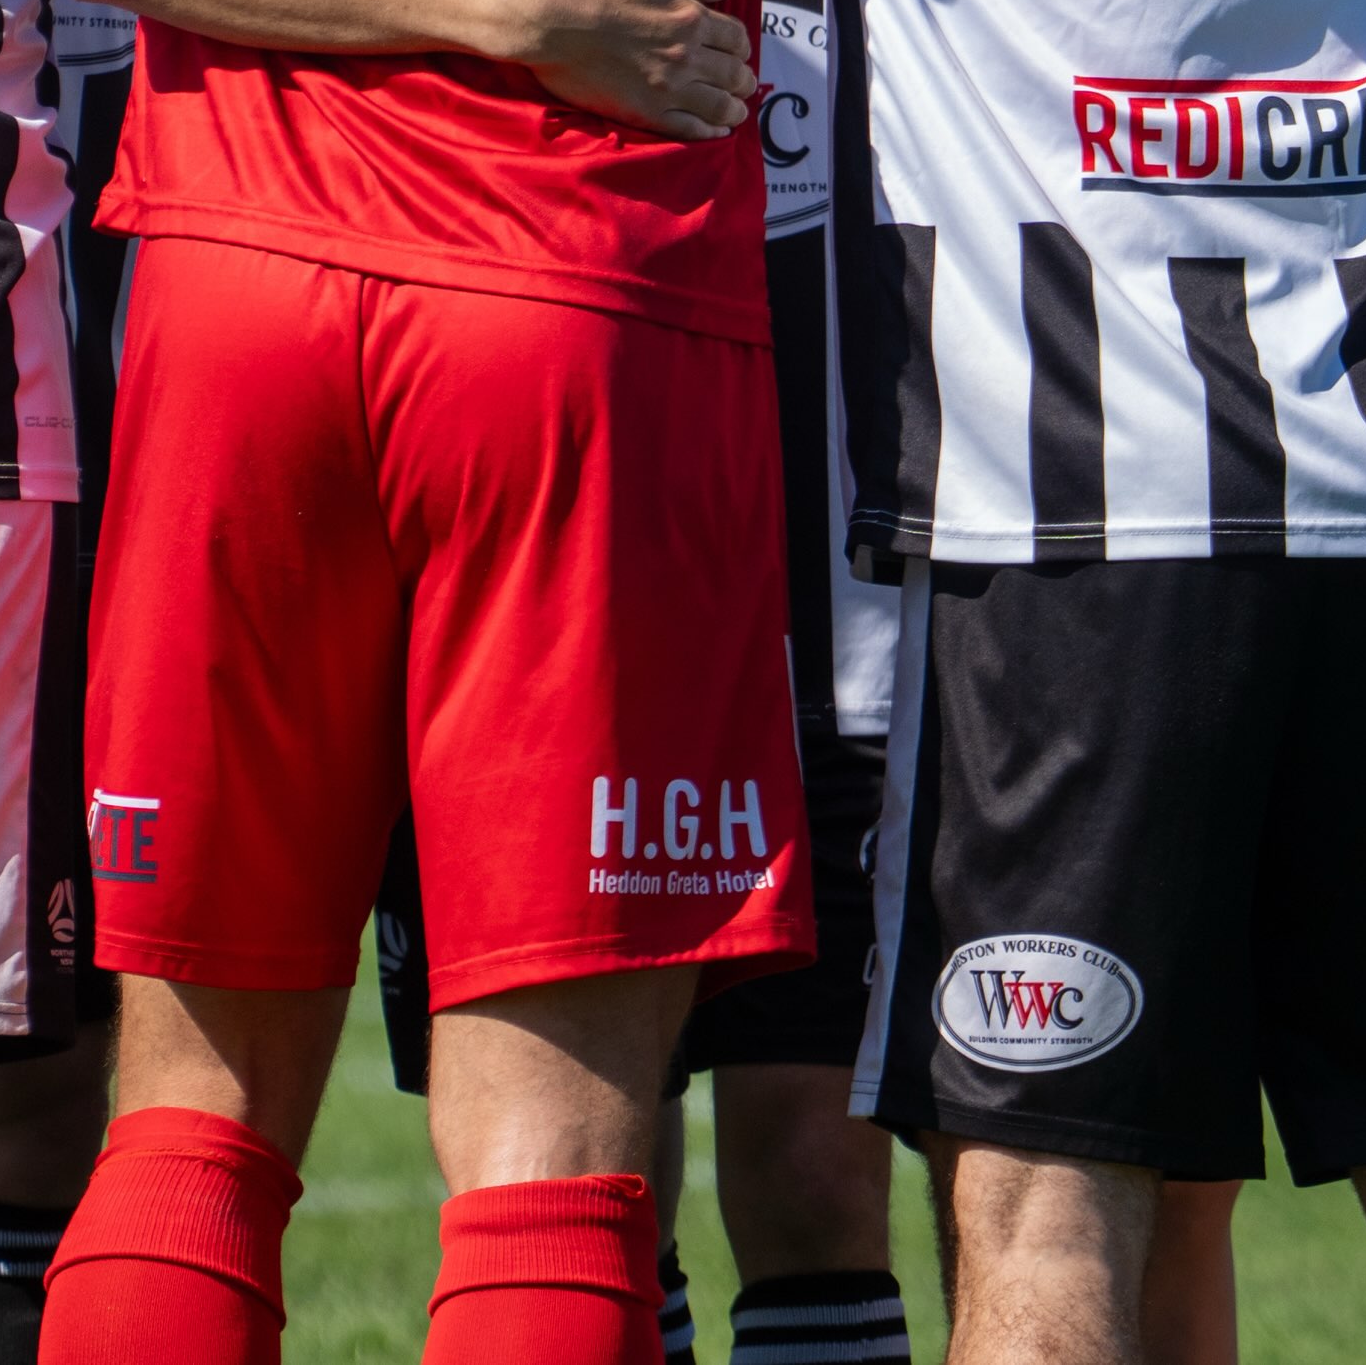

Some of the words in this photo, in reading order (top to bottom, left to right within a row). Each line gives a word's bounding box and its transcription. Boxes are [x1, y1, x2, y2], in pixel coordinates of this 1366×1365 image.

[590, 775, 768, 861] H.G.H
[588, 868, 661, 895] Heddon
[666, 871, 710, 895] Greta
[715, 866, 775, 895] Hotel
[950, 942, 996, 973] WESTON
[1002, 939, 1078, 958] WORKERS
[1082, 949, 1122, 977] CLUB
[968, 1035, 998, 1045] BUILDING
[999, 1036, 1048, 1046] COMMUNITY
[1049, 1036, 1094, 1045] STRENGTH
